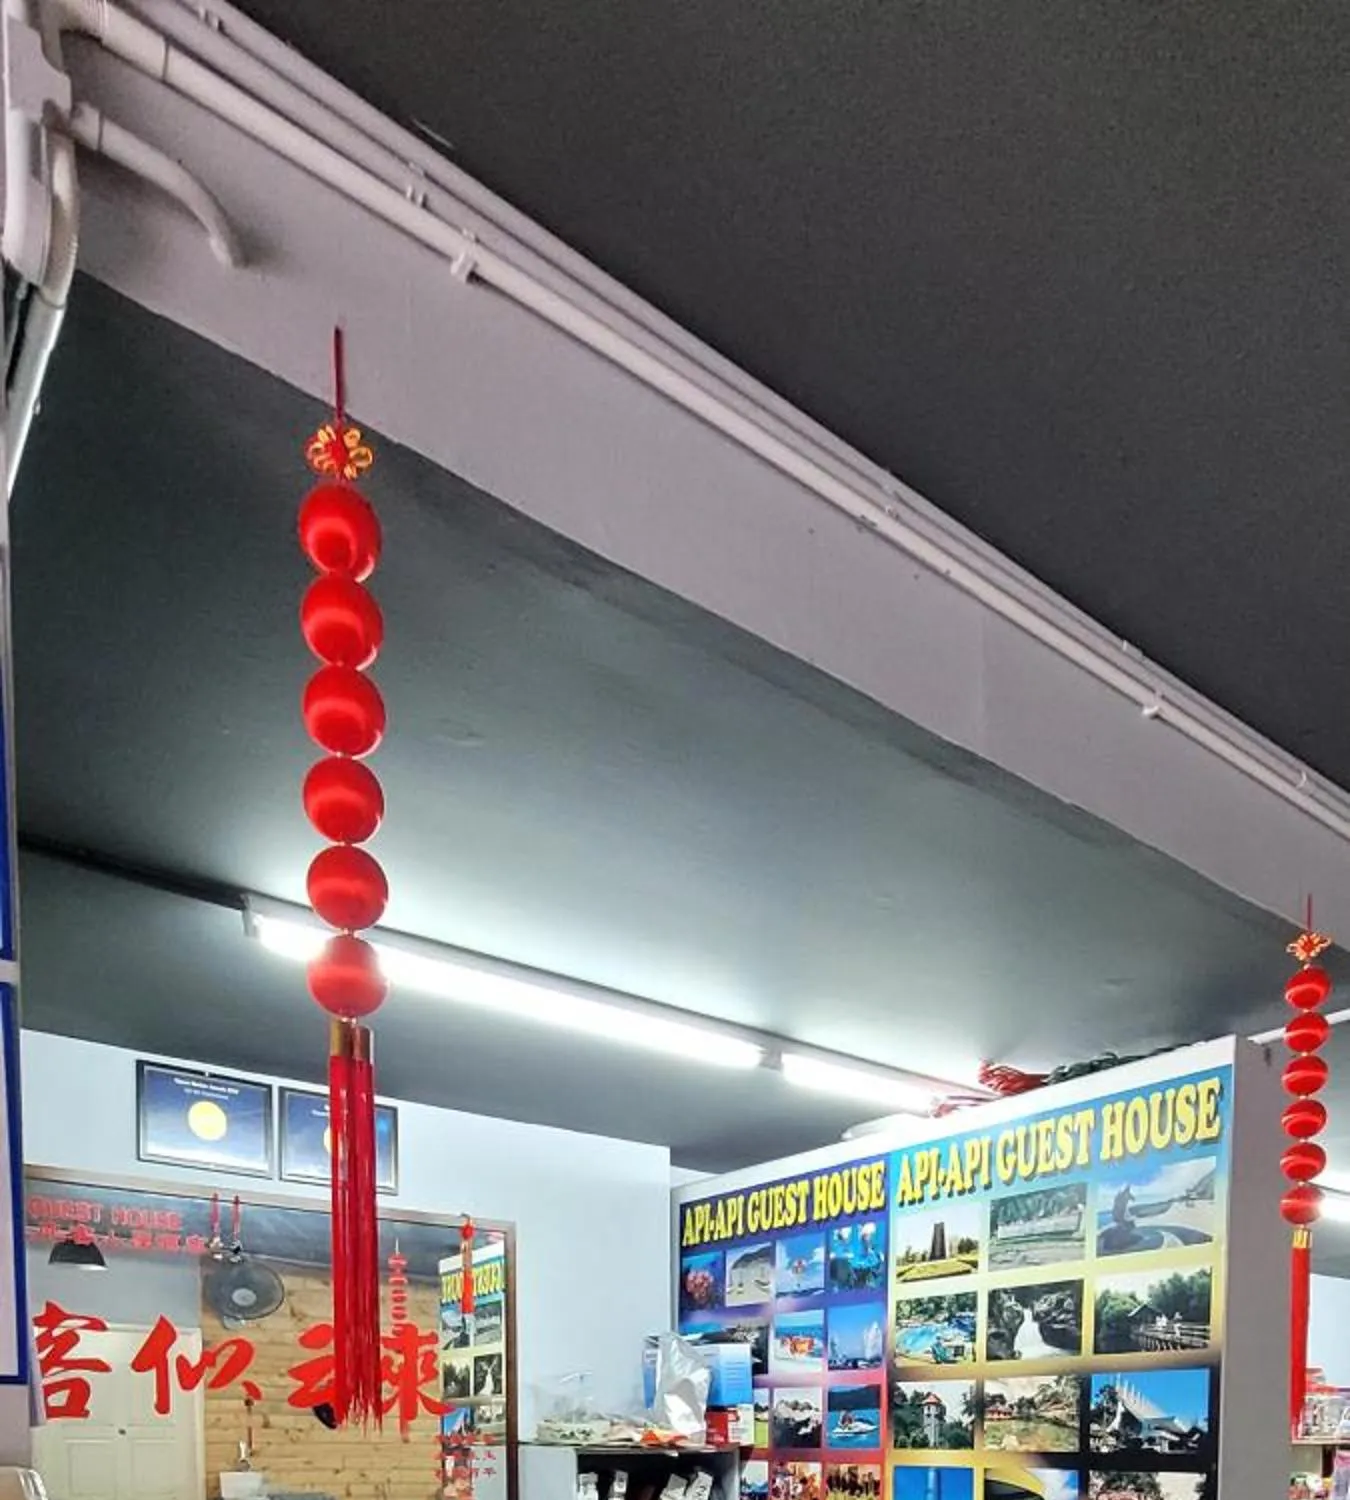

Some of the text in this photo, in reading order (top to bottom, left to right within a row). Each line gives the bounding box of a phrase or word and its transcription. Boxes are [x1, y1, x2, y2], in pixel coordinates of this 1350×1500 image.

[896, 1077, 1223, 1205] API-API GUEST HOUSE
[27, 1194, 183, 1232] GUEST HOUSE
[682, 1160, 885, 1247] API-API GUEST HOUSE
